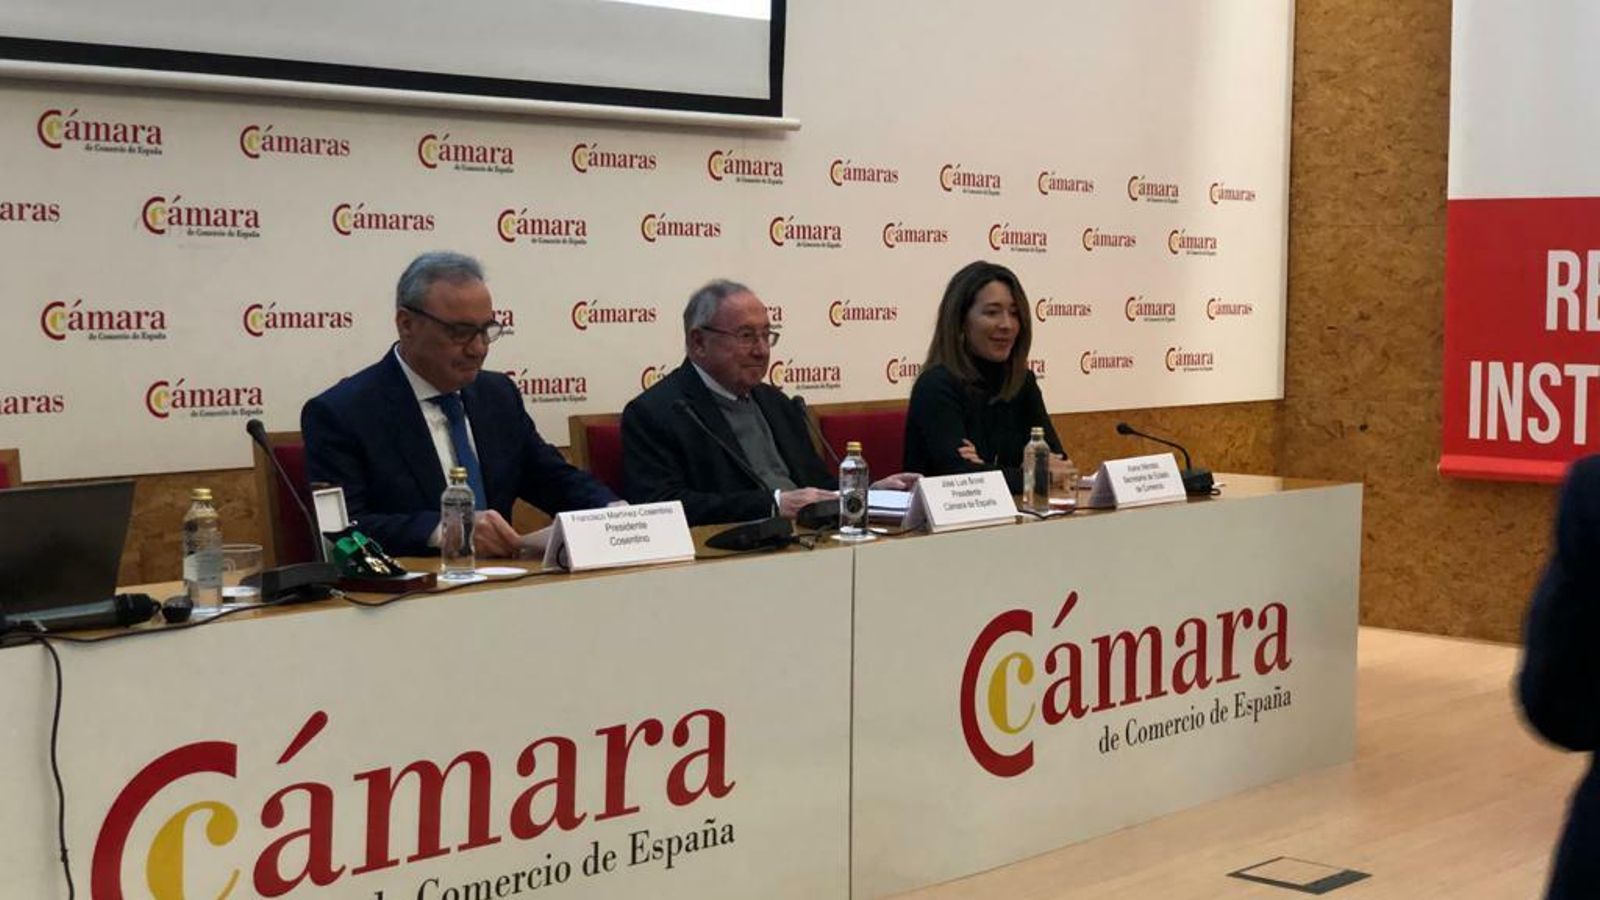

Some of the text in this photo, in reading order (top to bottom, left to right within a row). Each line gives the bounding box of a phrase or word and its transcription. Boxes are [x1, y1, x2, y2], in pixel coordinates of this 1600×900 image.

[0, 394, 64, 415] aras
[1099, 685, 1292, 754] de Comercio de España
[582, 841, 617, 878] de
[628, 818, 735, 869] España
